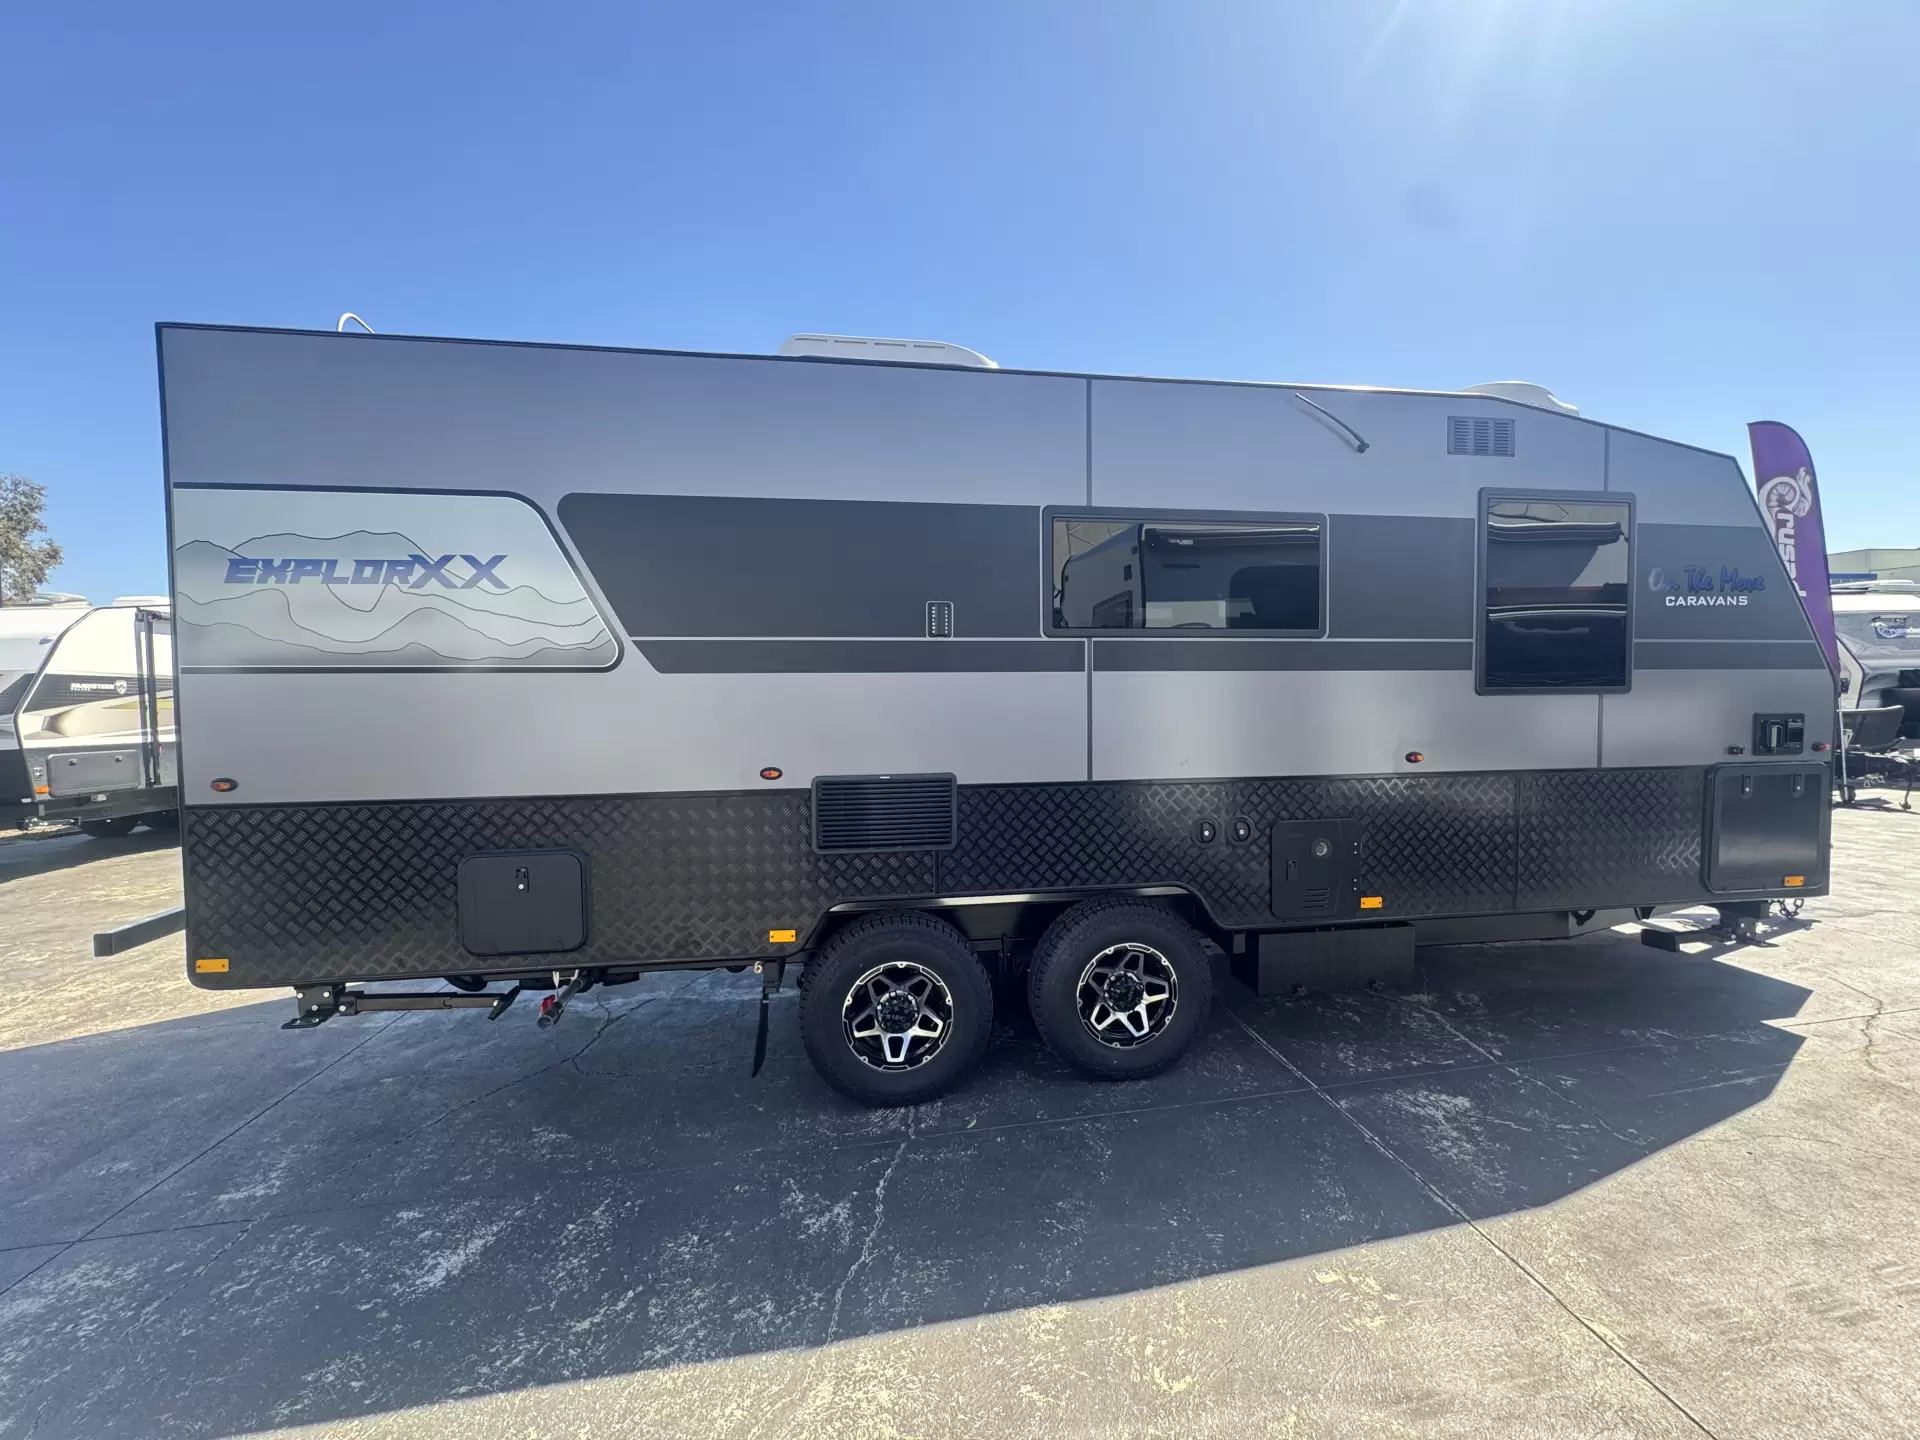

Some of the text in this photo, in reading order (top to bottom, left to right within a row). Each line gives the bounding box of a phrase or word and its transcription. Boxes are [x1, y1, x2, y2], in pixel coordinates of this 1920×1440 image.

[223, 554, 510, 589] EXPLORXX
[1648, 565, 1765, 594] On The Move
[1665, 596, 1748, 607] CARAVANS
